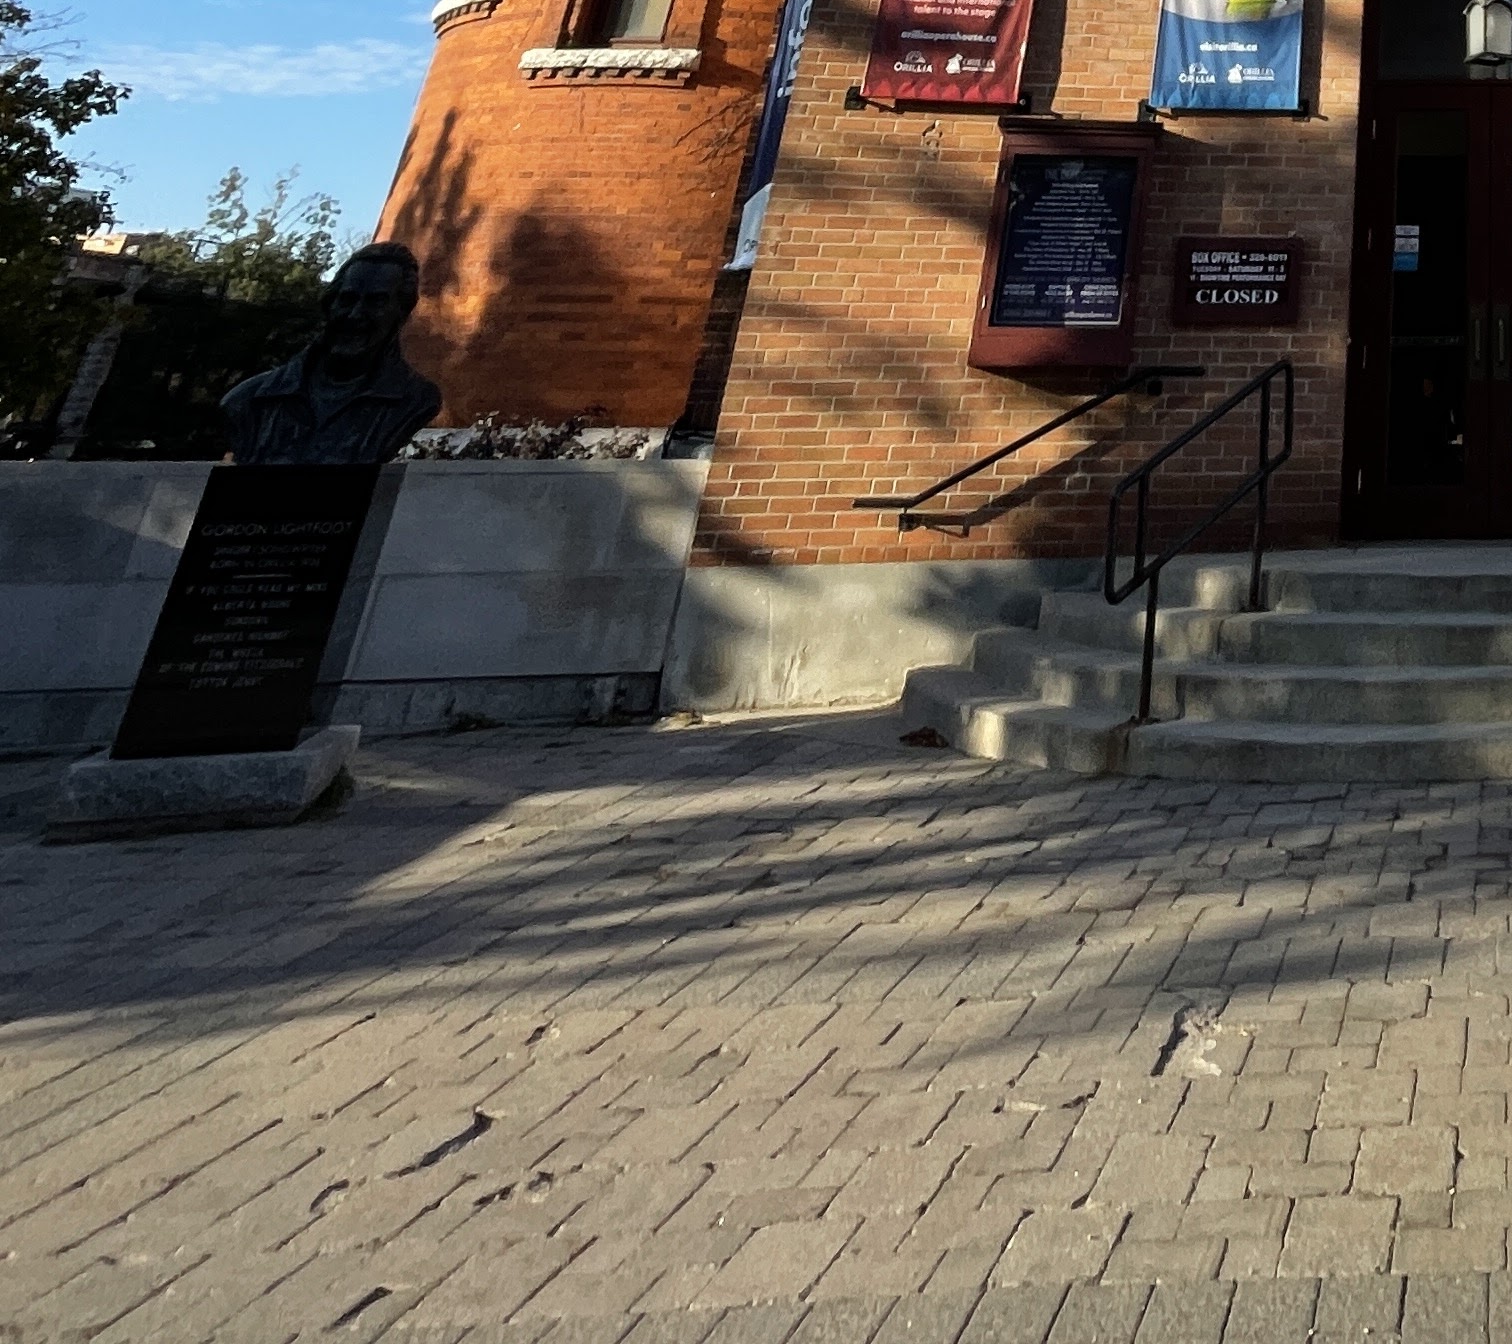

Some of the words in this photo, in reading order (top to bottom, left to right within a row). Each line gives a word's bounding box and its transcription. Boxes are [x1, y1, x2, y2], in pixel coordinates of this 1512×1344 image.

[914, 4, 941, 14] talent
[942, 6, 952, 15] to
[954, 5, 969, 16] the
[970, 8, 997, 19] stage
[893, 62, 933, 73] ORILLIA
[1195, 288, 1279, 305] CLOSED
[201, 522, 268, 537] GORDON
[273, 520, 354, 535] LIGHTFOOT
